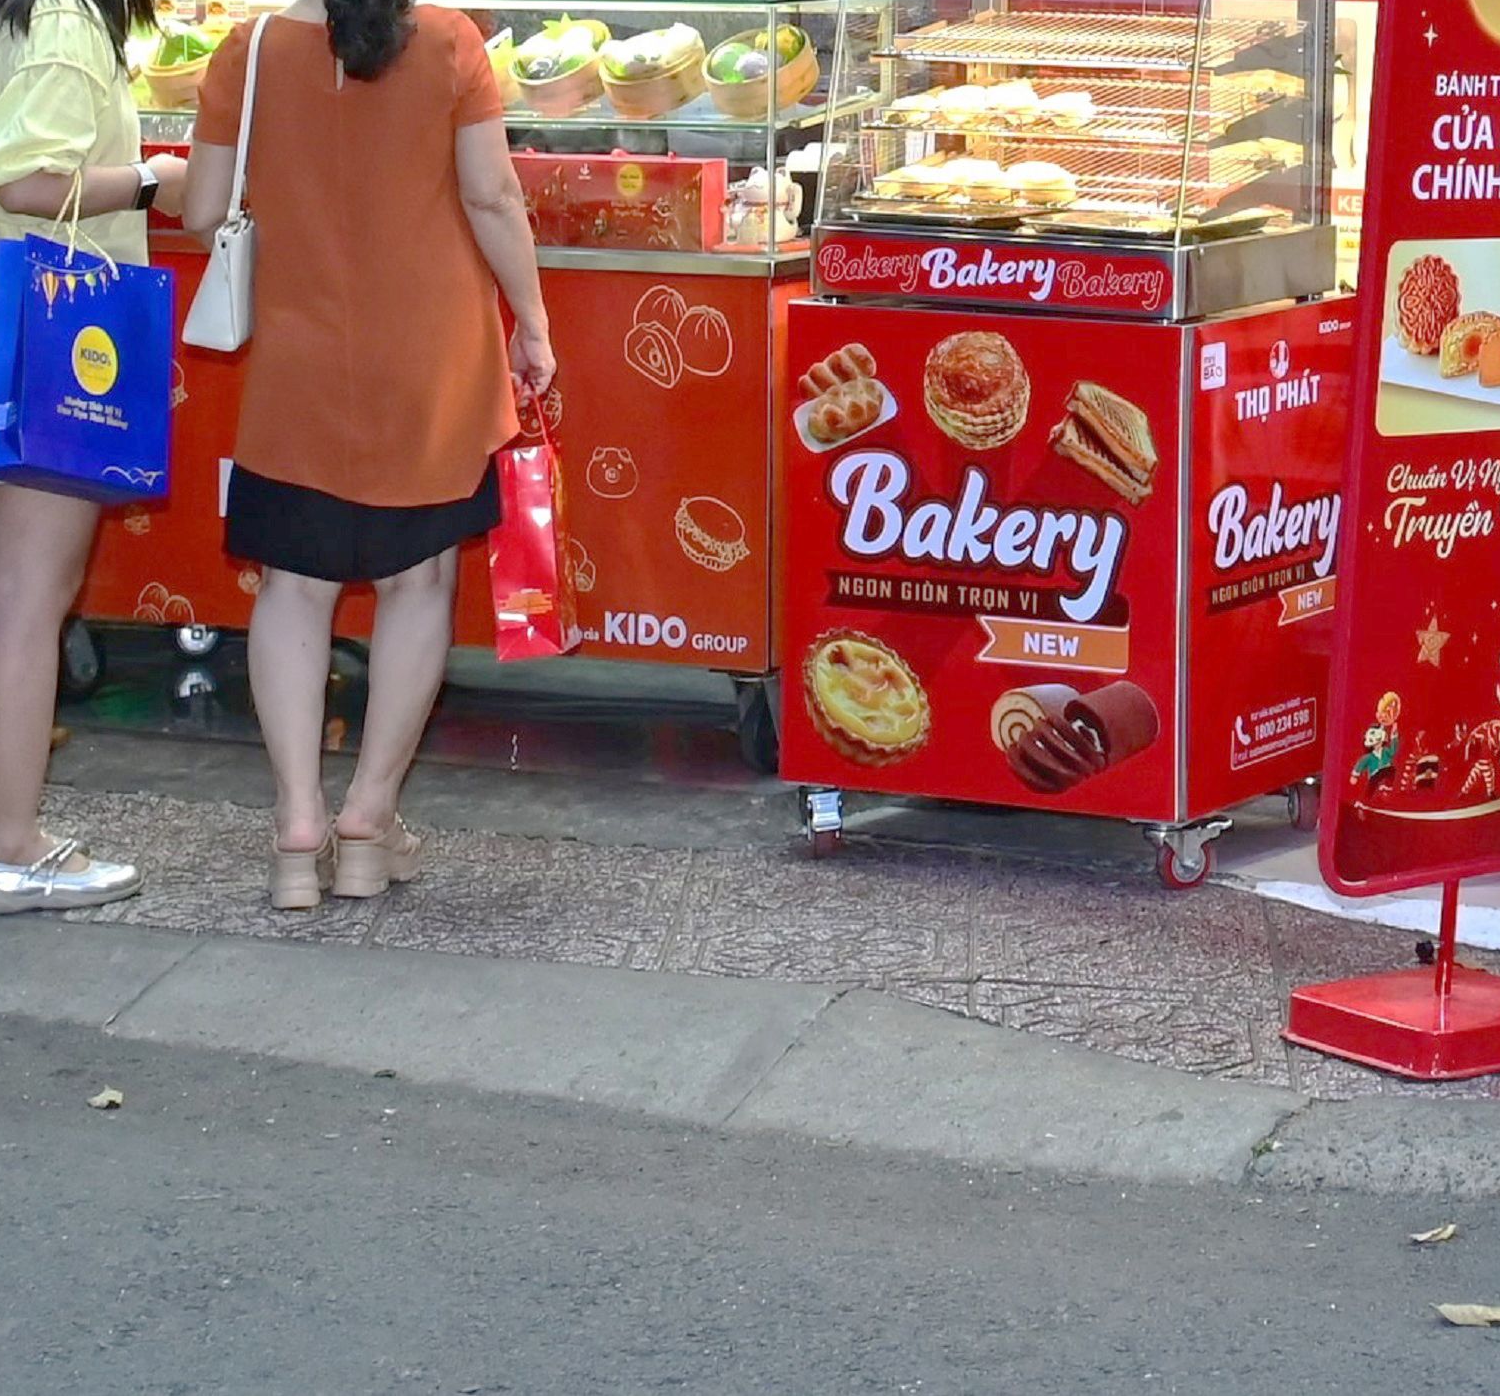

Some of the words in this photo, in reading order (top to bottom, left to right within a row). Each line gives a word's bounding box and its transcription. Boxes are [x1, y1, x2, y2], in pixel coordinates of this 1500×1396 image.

[1436, 71, 1486, 98] BÁNH
[1432, 107, 1493, 151] CỬA
[1235, 385, 1270, 423] THỌ
[1276, 368, 1321, 412] PHÁT
[831, 450, 1124, 623] Bakery
[1208, 480, 1341, 576] Bakery
[838, 576, 893, 598] NGON
[900, 579, 948, 604] GIÒN
[957, 585, 1010, 611] TRỌN
[1019, 590, 1040, 615] VỊ
[1297, 588, 1323, 611] NEW
[604, 611, 688, 648] KIDO
[691, 634, 748, 653] GROUP
[1022, 631, 1080, 658] NEW
